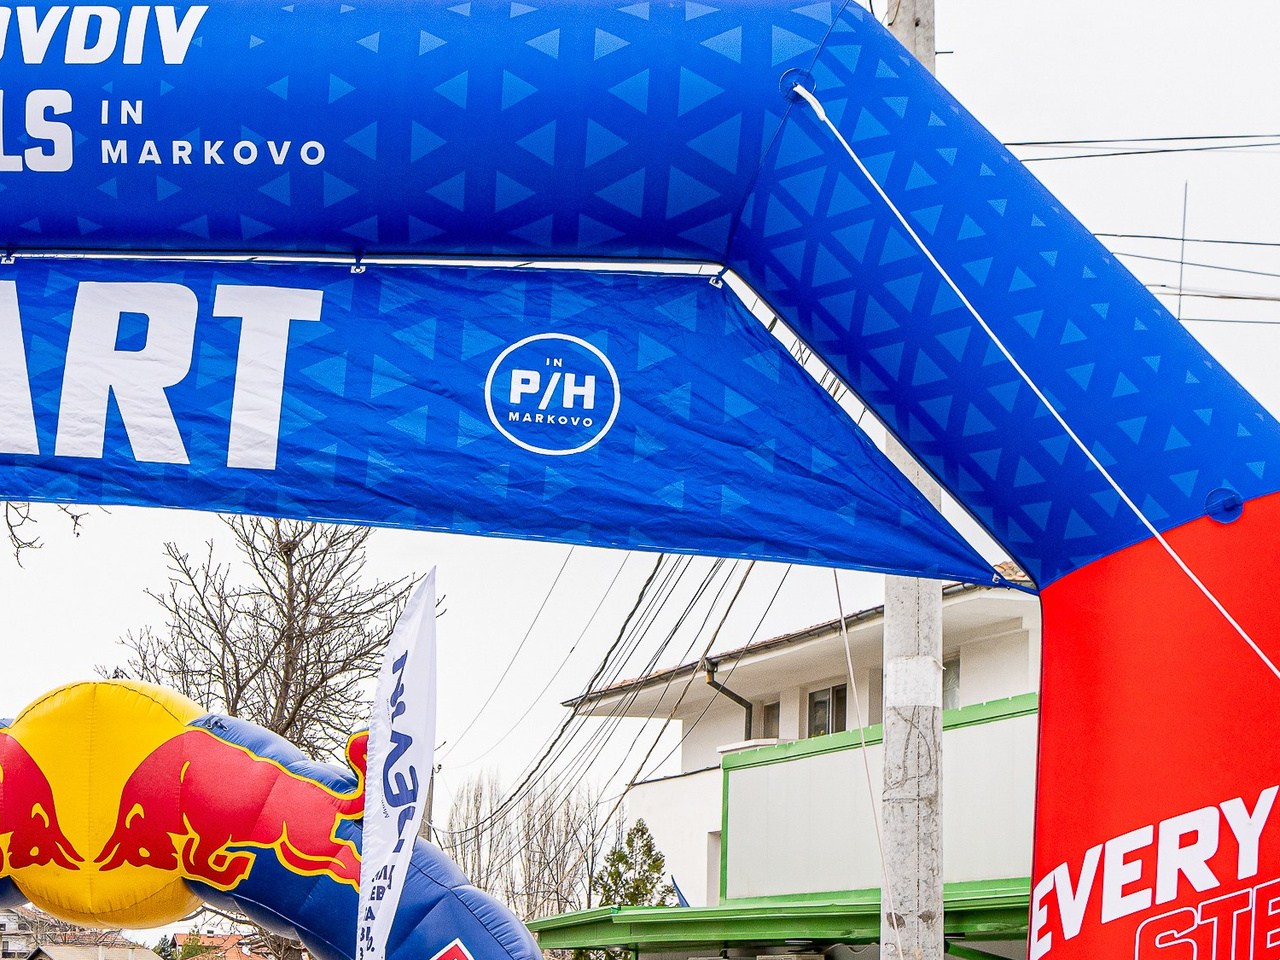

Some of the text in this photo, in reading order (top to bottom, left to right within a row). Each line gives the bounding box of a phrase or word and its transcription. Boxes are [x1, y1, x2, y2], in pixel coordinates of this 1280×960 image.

[101, 100, 143, 125] IN
[101, 140, 326, 166] MARKOVO
[546, 358, 562, 367] IN
[510, 369, 596, 410] P/H
[508, 412, 593, 427] MARKOVO
